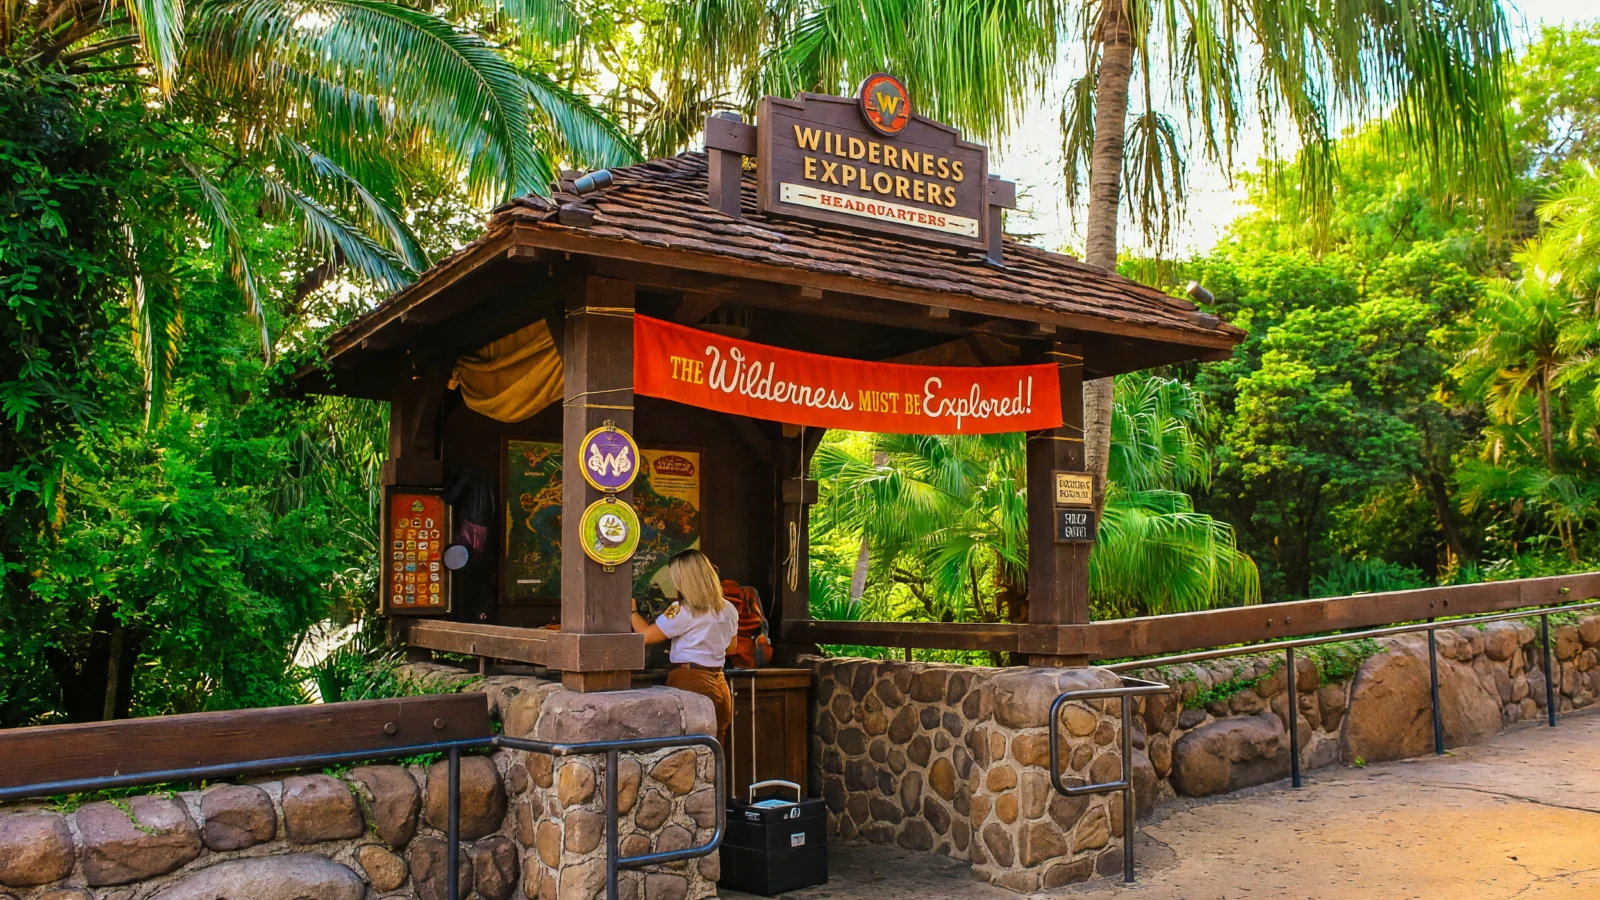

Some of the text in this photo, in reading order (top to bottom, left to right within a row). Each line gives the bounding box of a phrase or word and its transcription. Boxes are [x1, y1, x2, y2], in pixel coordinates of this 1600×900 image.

[876, 91, 899, 115] W
[793, 124, 965, 182] WILDERNESS
[804, 156, 957, 208] EXPLORERS
[820, 194, 946, 227] HEADQUARTERS
[670, 345, 1033, 430] THE Wilderness MUST BE Explored!
